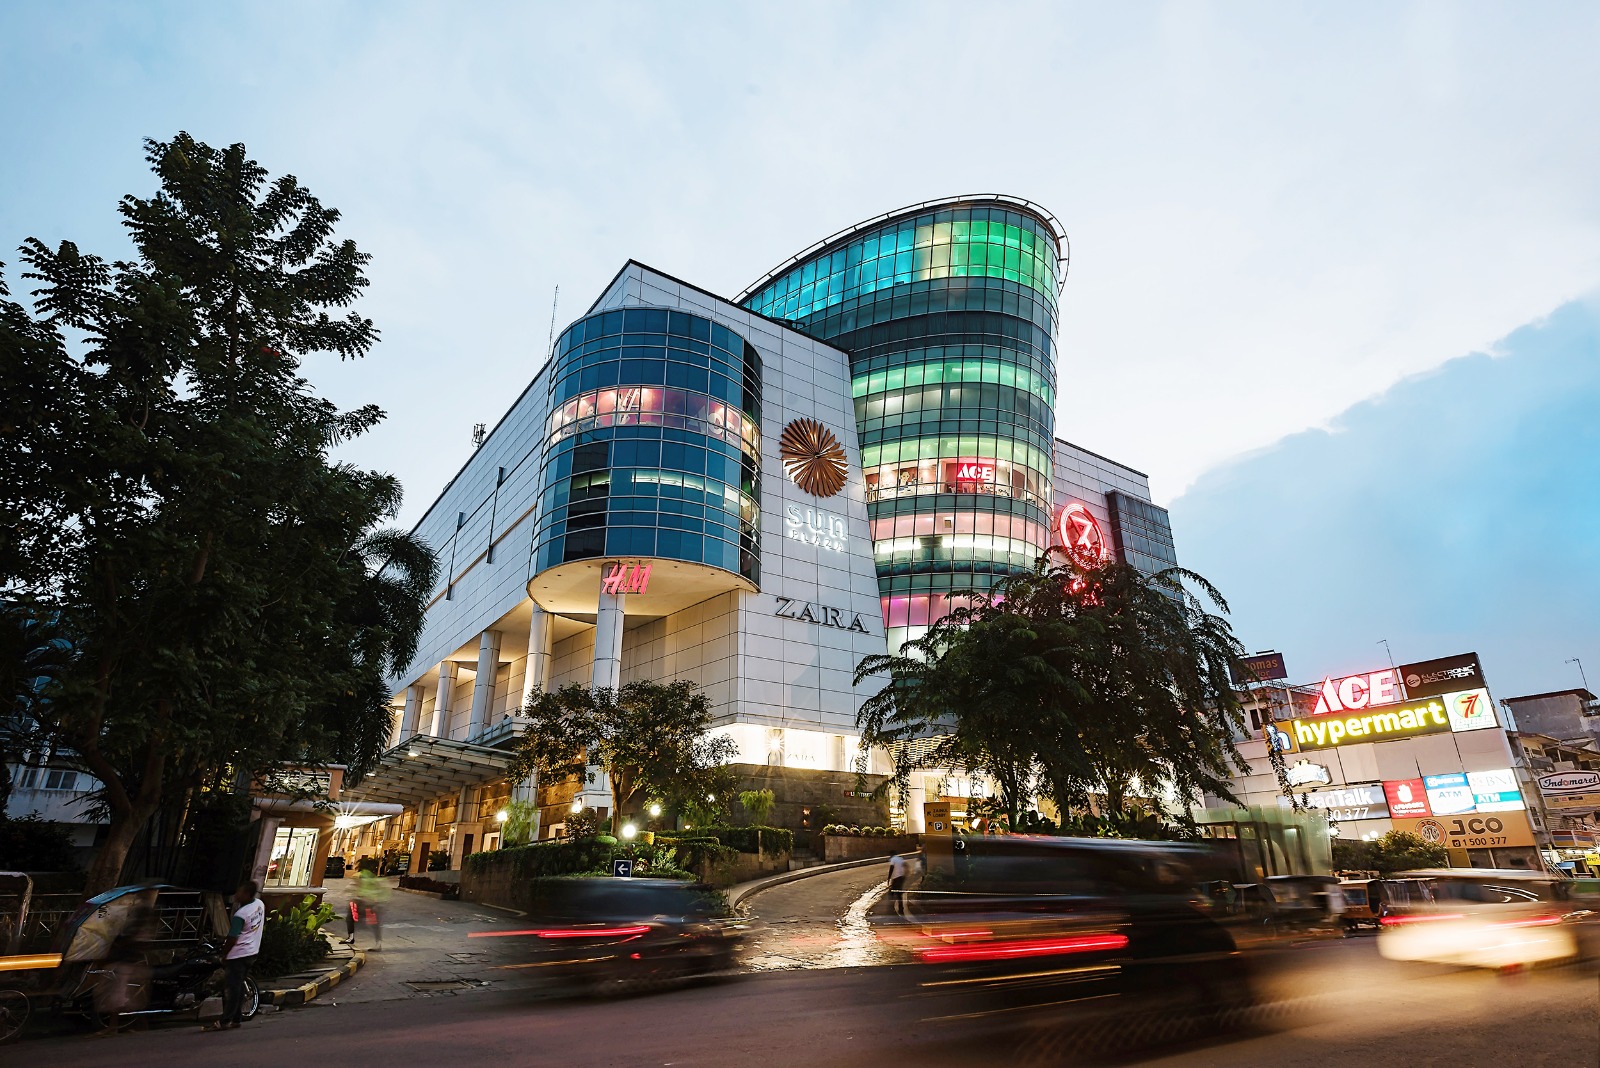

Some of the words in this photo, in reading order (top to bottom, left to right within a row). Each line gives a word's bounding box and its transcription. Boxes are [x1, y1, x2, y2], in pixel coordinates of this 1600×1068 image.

[957, 464, 992, 479] ACE
[786, 504, 848, 541] sun
[602, 564, 653, 595] H&M
[775, 596, 870, 633] ZARA
[1313, 670, 1394, 715] ACE
[1294, 702, 1446, 745] hypermart
[1543, 775, 1598, 787] Indomaret
[1438, 790, 1462, 798] ATM
[1477, 793, 1501, 803] ATM
[1345, 807, 1369, 819] 377
[1449, 817, 1503, 836] J.CO
[1469, 837, 1487, 846] 500
[1489, 836, 1507, 845] 377
